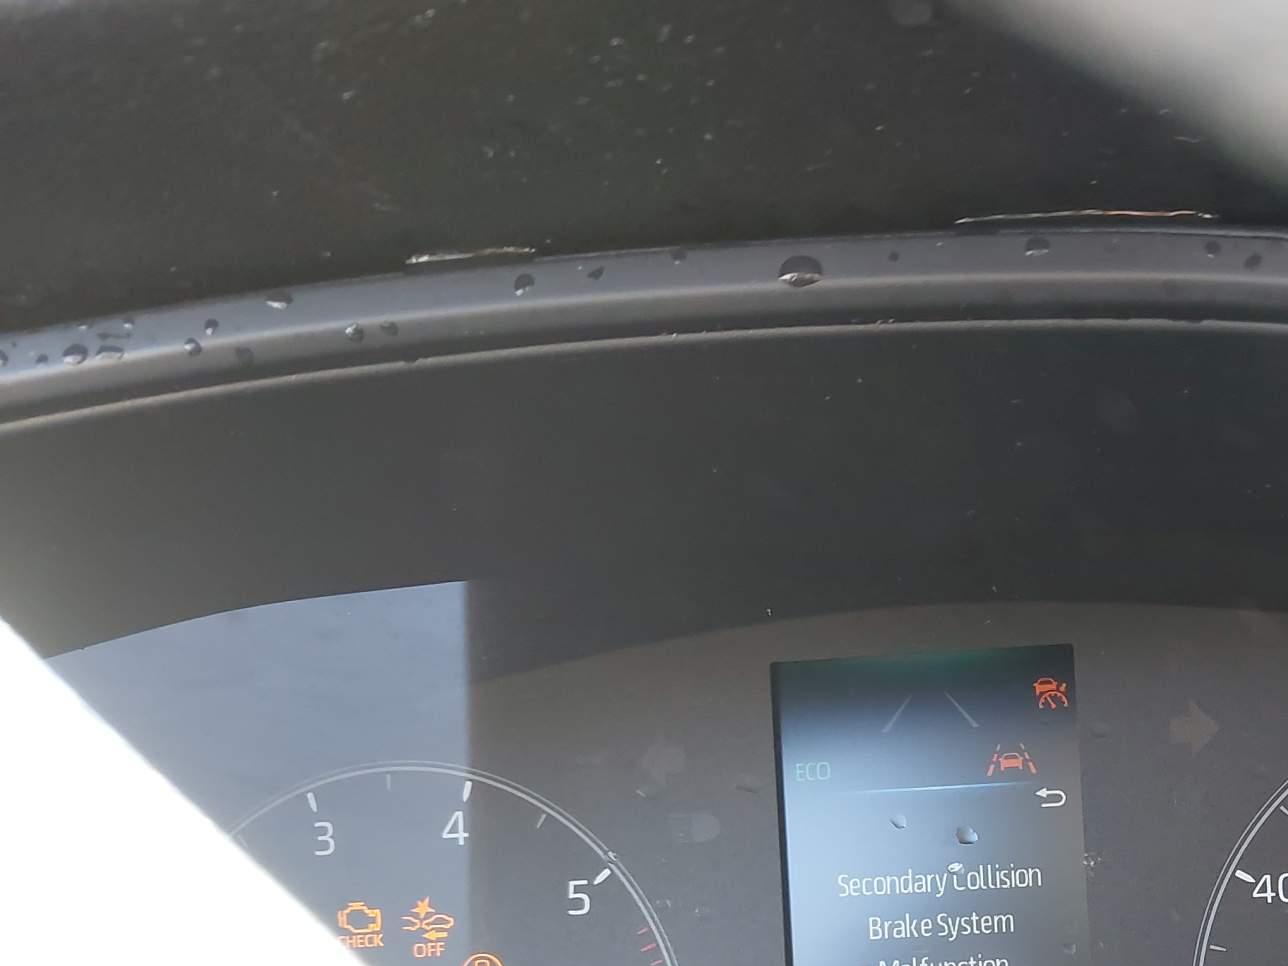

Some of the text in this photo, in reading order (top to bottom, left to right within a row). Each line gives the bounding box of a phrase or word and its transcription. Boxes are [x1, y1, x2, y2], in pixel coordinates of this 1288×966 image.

[795, 762, 831, 782] ECO
[314, 822, 335, 855] 3
[441, 811, 468, 845] 4
[838, 864, 1042, 898] Secondary Collision
[567, 880, 590, 916] 5
[869, 911, 1014, 940] Brake System
[414, 943, 445, 957] OFF
